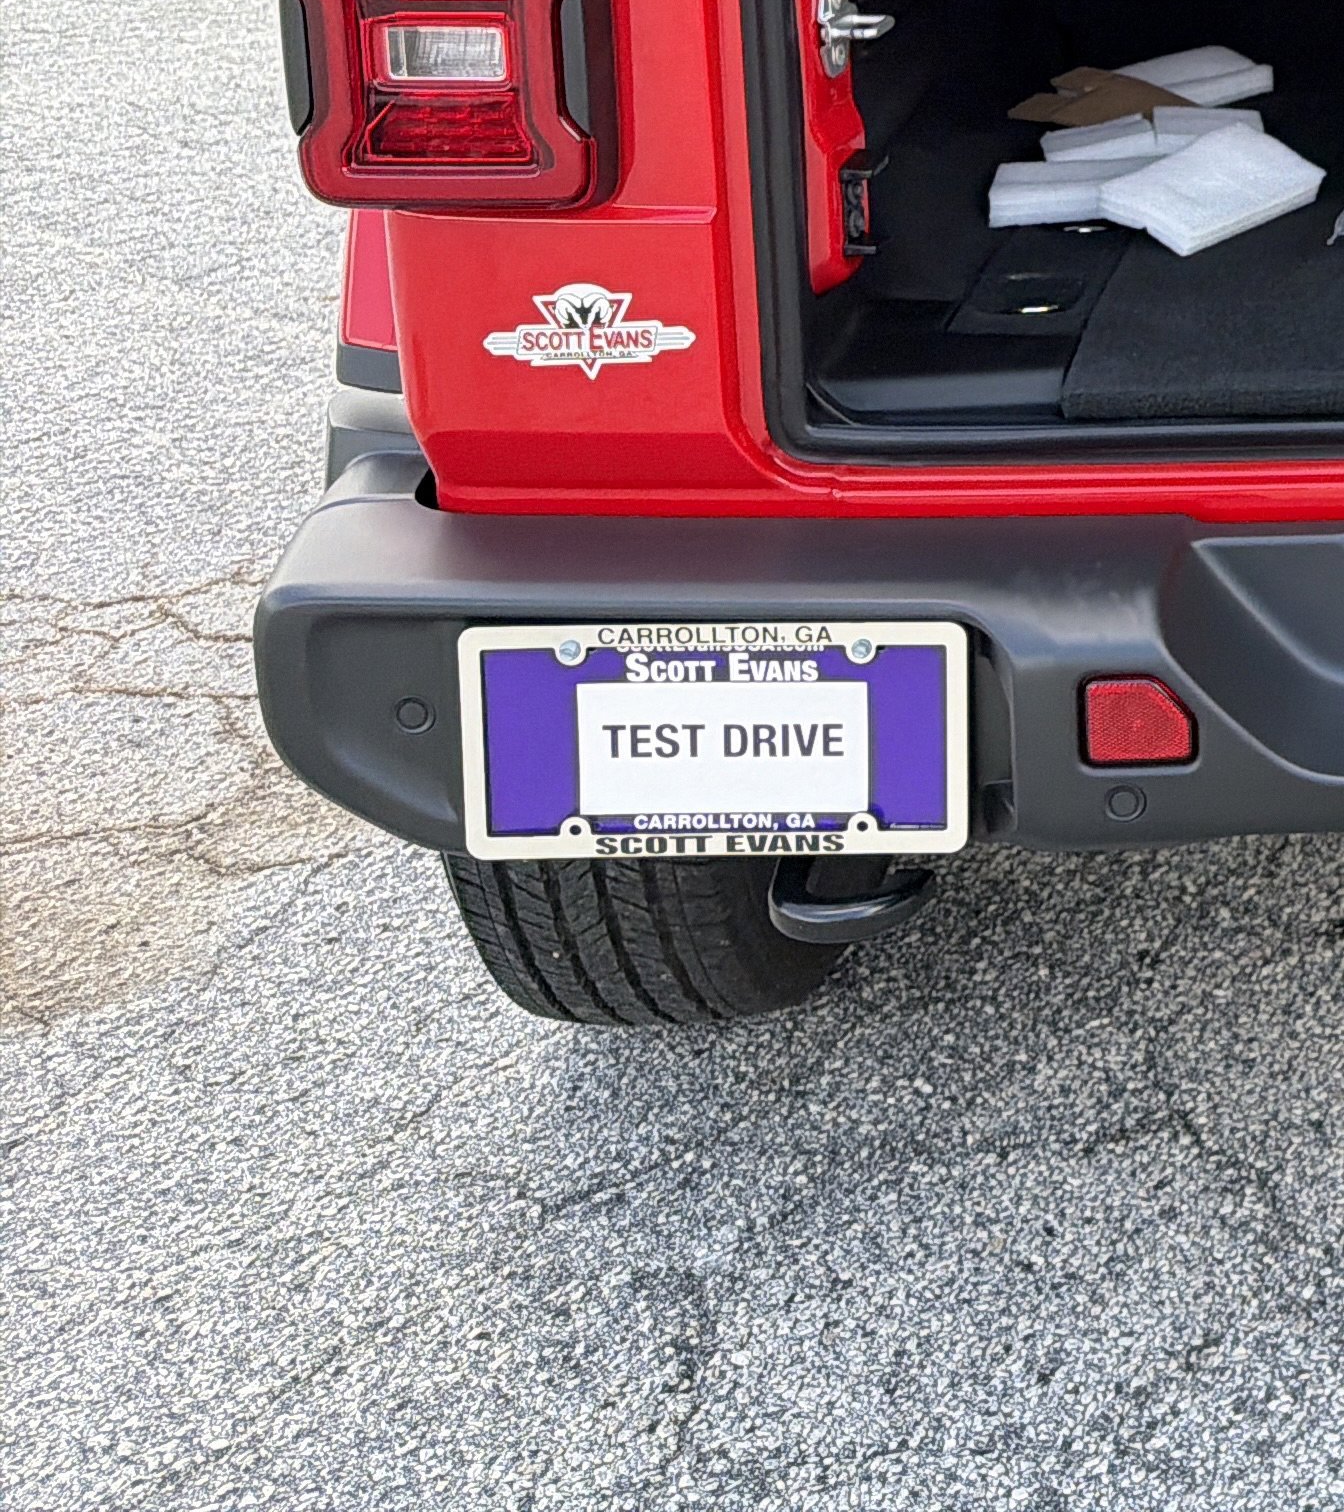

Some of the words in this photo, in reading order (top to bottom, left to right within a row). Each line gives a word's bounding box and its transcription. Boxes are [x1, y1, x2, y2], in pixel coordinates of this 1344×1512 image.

[521, 331, 585, 352] SCOTT
[589, 325, 653, 352] EVANS
[597, 626, 786, 645] CARROLLTON,
[794, 625, 833, 644] GA
[625, 652, 717, 683] SCOTT
[728, 652, 820, 682] EVANS
[602, 723, 705, 759] TEST
[722, 722, 845, 758] DRIVE
[633, 813, 778, 831] CARROLLTON,
[785, 813, 815, 830] GA
[595, 835, 713, 856] SCOTT
[726, 833, 845, 853] EVANS
